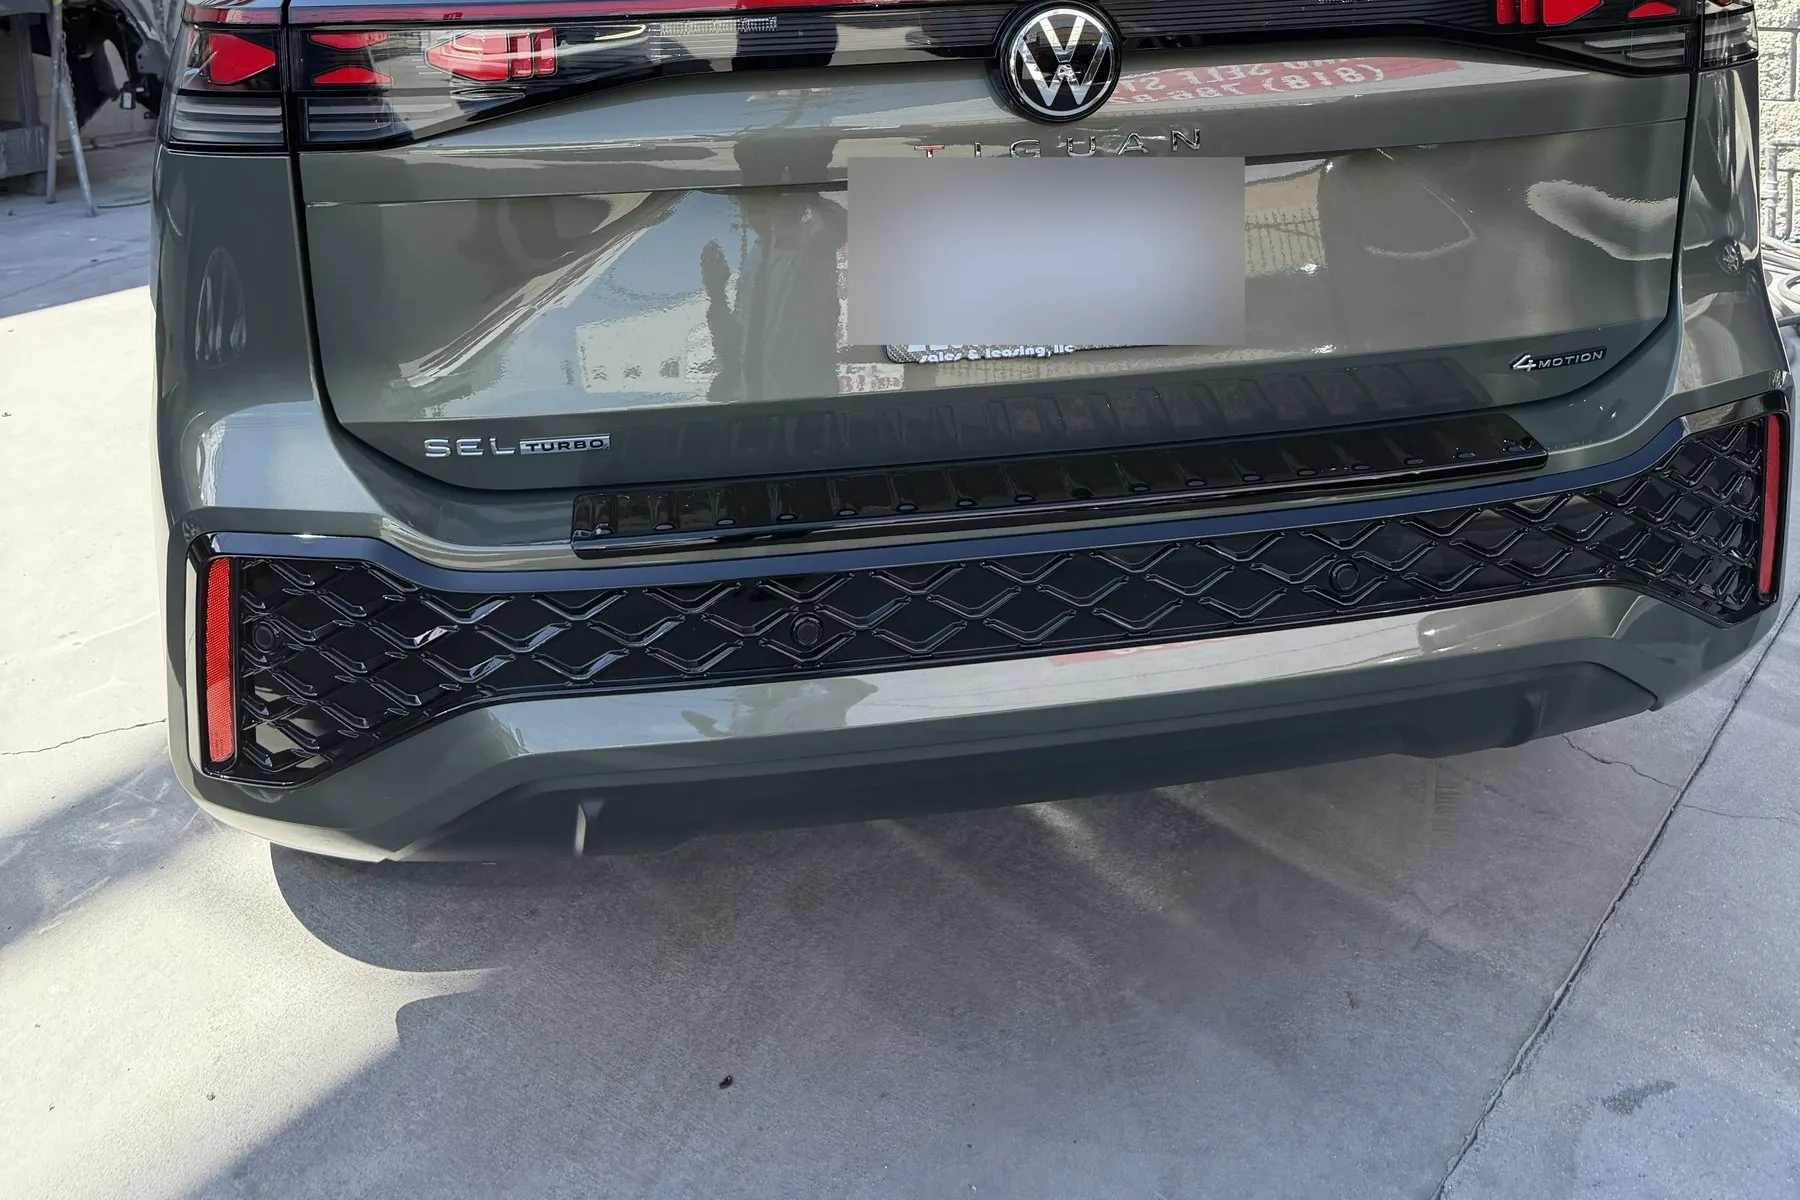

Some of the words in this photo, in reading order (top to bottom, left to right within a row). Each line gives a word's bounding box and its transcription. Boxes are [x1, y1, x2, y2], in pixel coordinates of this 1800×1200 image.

[913, 128, 1201, 158] TIGUAN
[919, 351, 962, 363] sales
[1512, 350, 1604, 372] 4MOTION
[424, 436, 516, 457] SEL
[522, 436, 609, 454] TURBO
